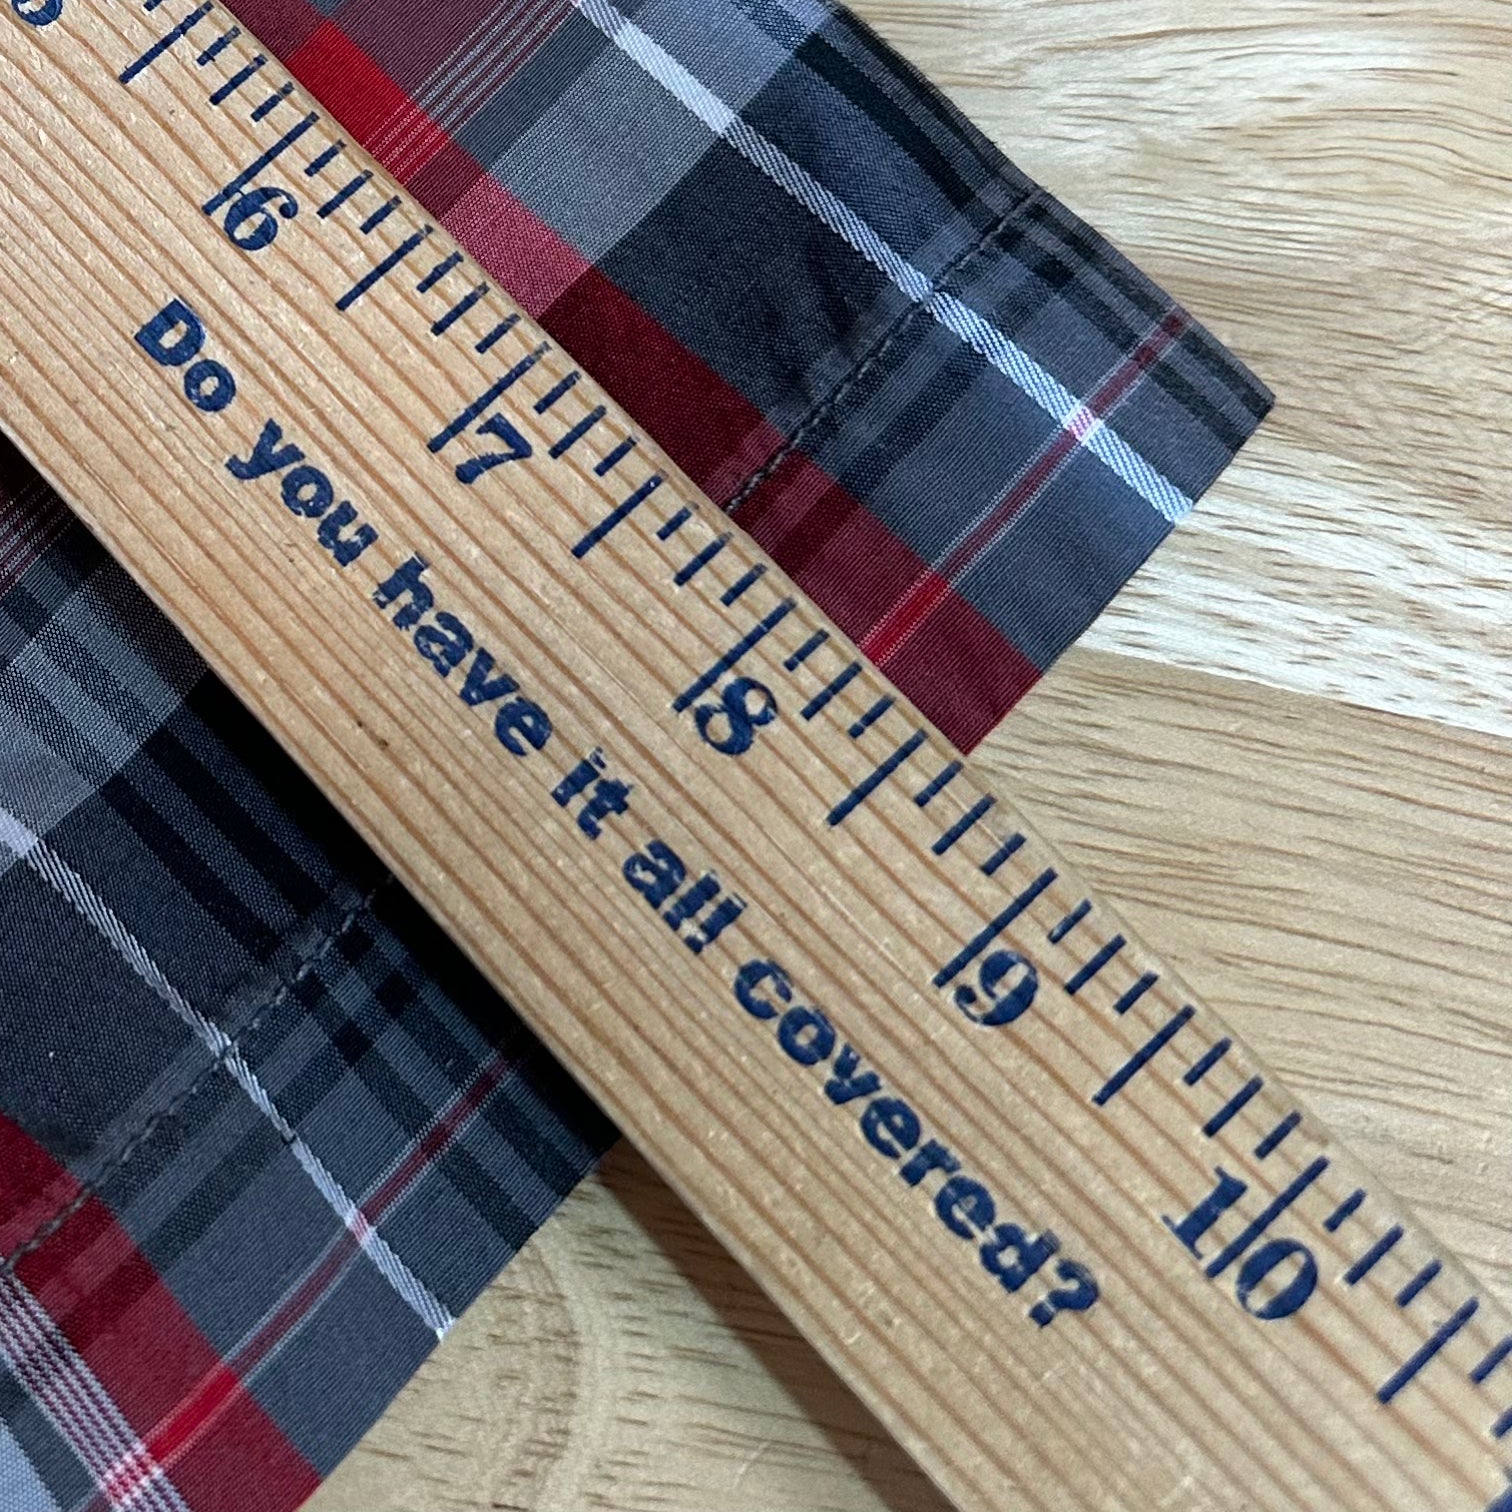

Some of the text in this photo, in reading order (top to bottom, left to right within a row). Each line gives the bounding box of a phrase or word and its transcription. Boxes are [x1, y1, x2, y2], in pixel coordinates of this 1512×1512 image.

[223, 186, 299, 251] 6
[456, 413, 532, 484] 7
[694, 676, 777, 755] 8
[134, 299, 1099, 1327] Do you have it all covered?
[954, 950, 1039, 1026] 9
[1162, 1167, 1318, 1320] 10
